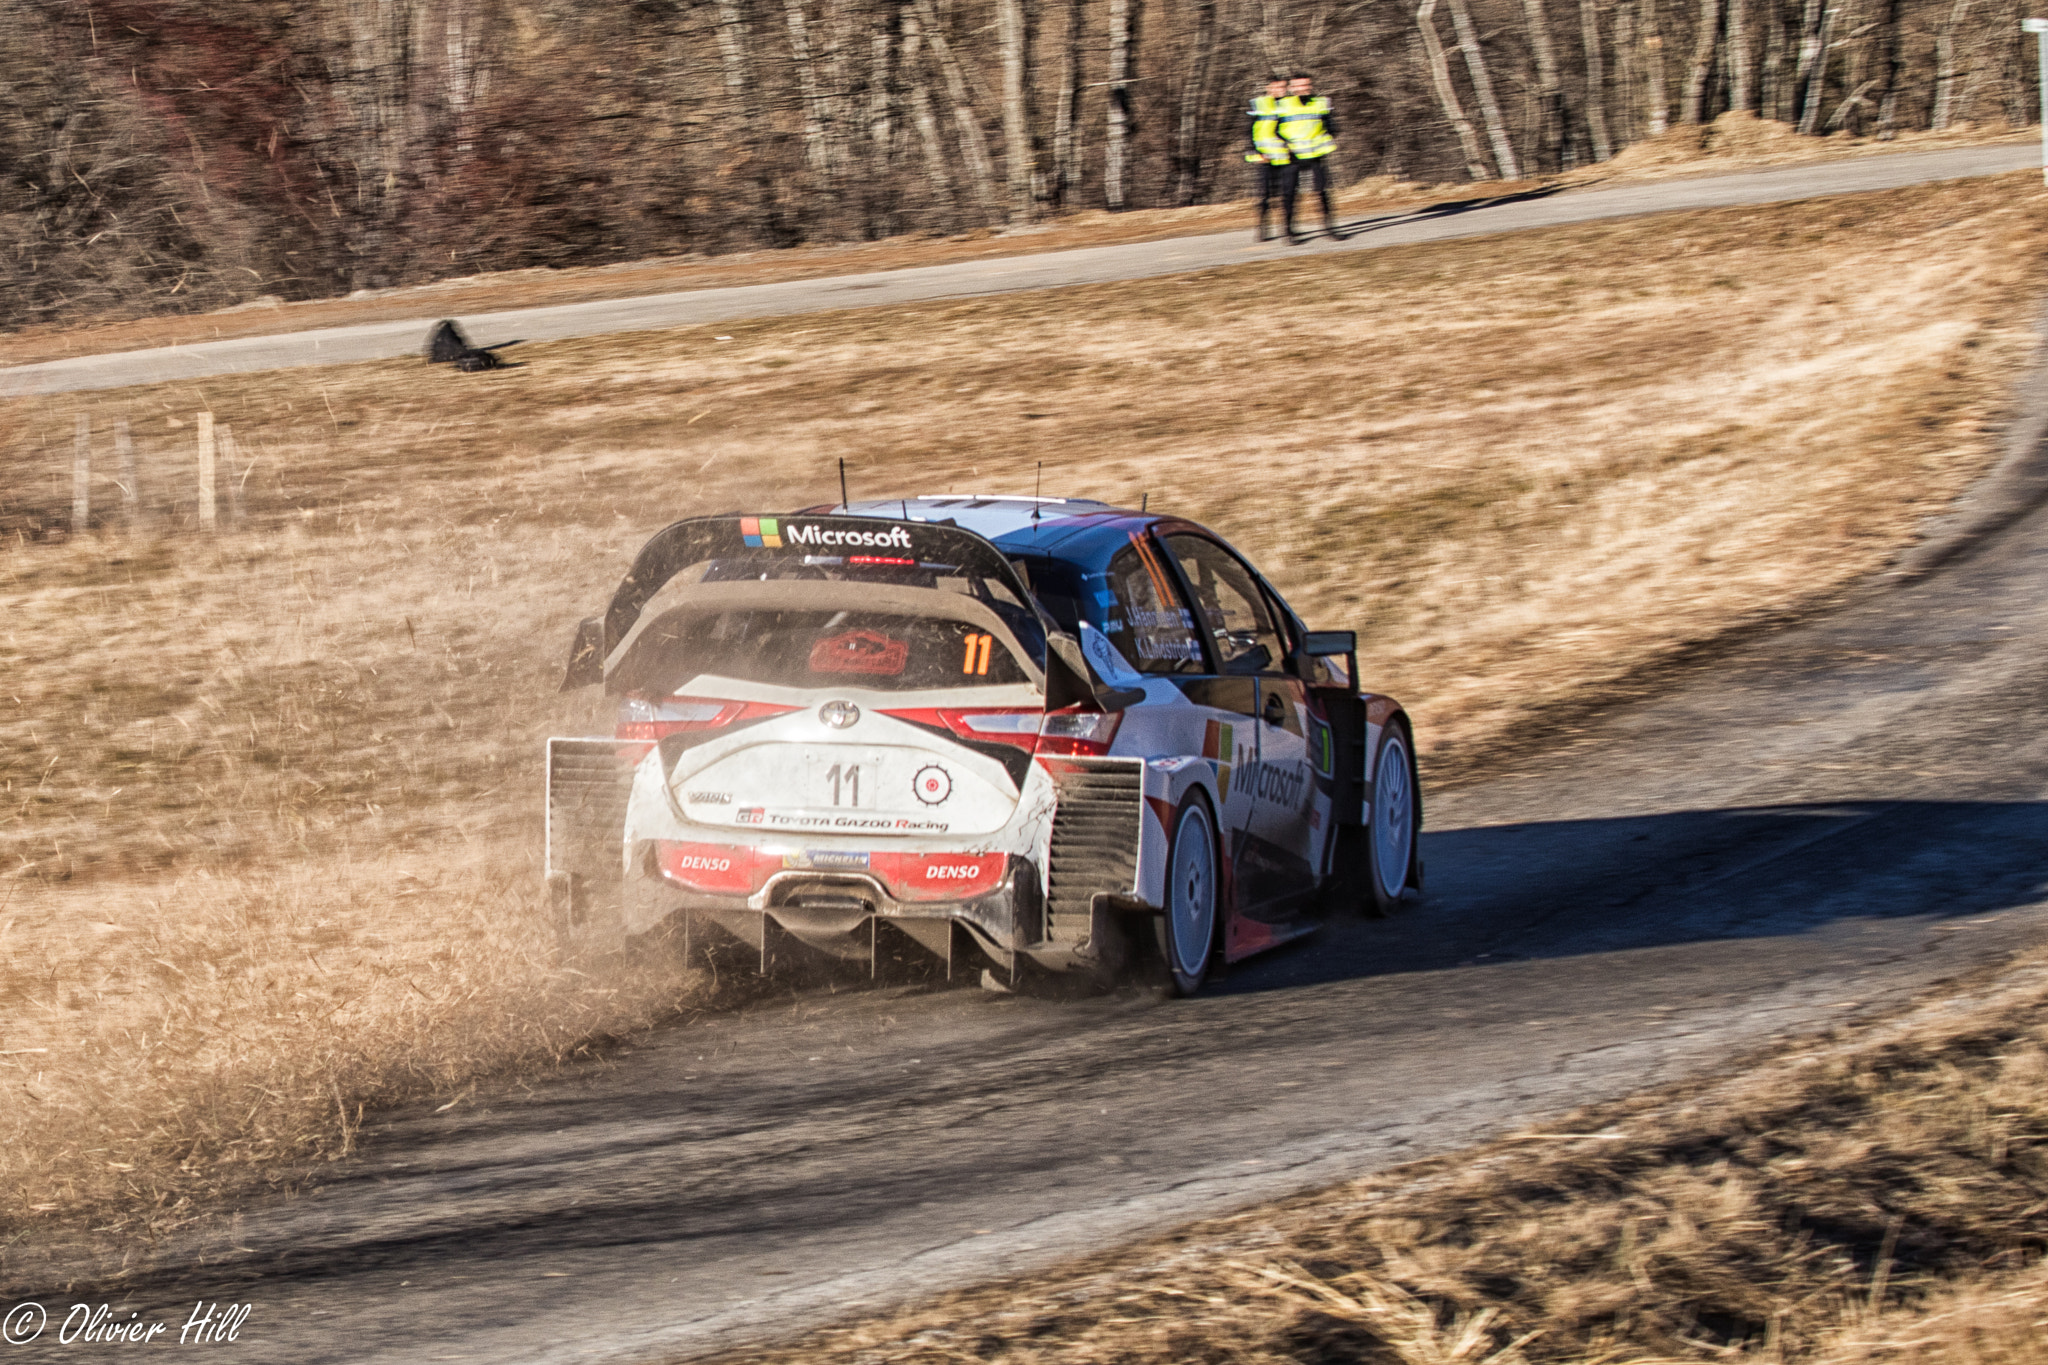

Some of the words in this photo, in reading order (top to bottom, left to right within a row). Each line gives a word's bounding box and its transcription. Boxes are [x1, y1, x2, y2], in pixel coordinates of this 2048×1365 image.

[786, 525, 912, 548] Microsoft
[963, 633, 992, 675] 11
[826, 764, 860, 807] 11
[834, 817, 892, 829] GAZOO
[895, 819, 950, 832] Racing
[681, 855, 730, 872] DENSO
[813, 854, 868, 865] MICHELIN
[926, 865, 980, 879] DENSO
